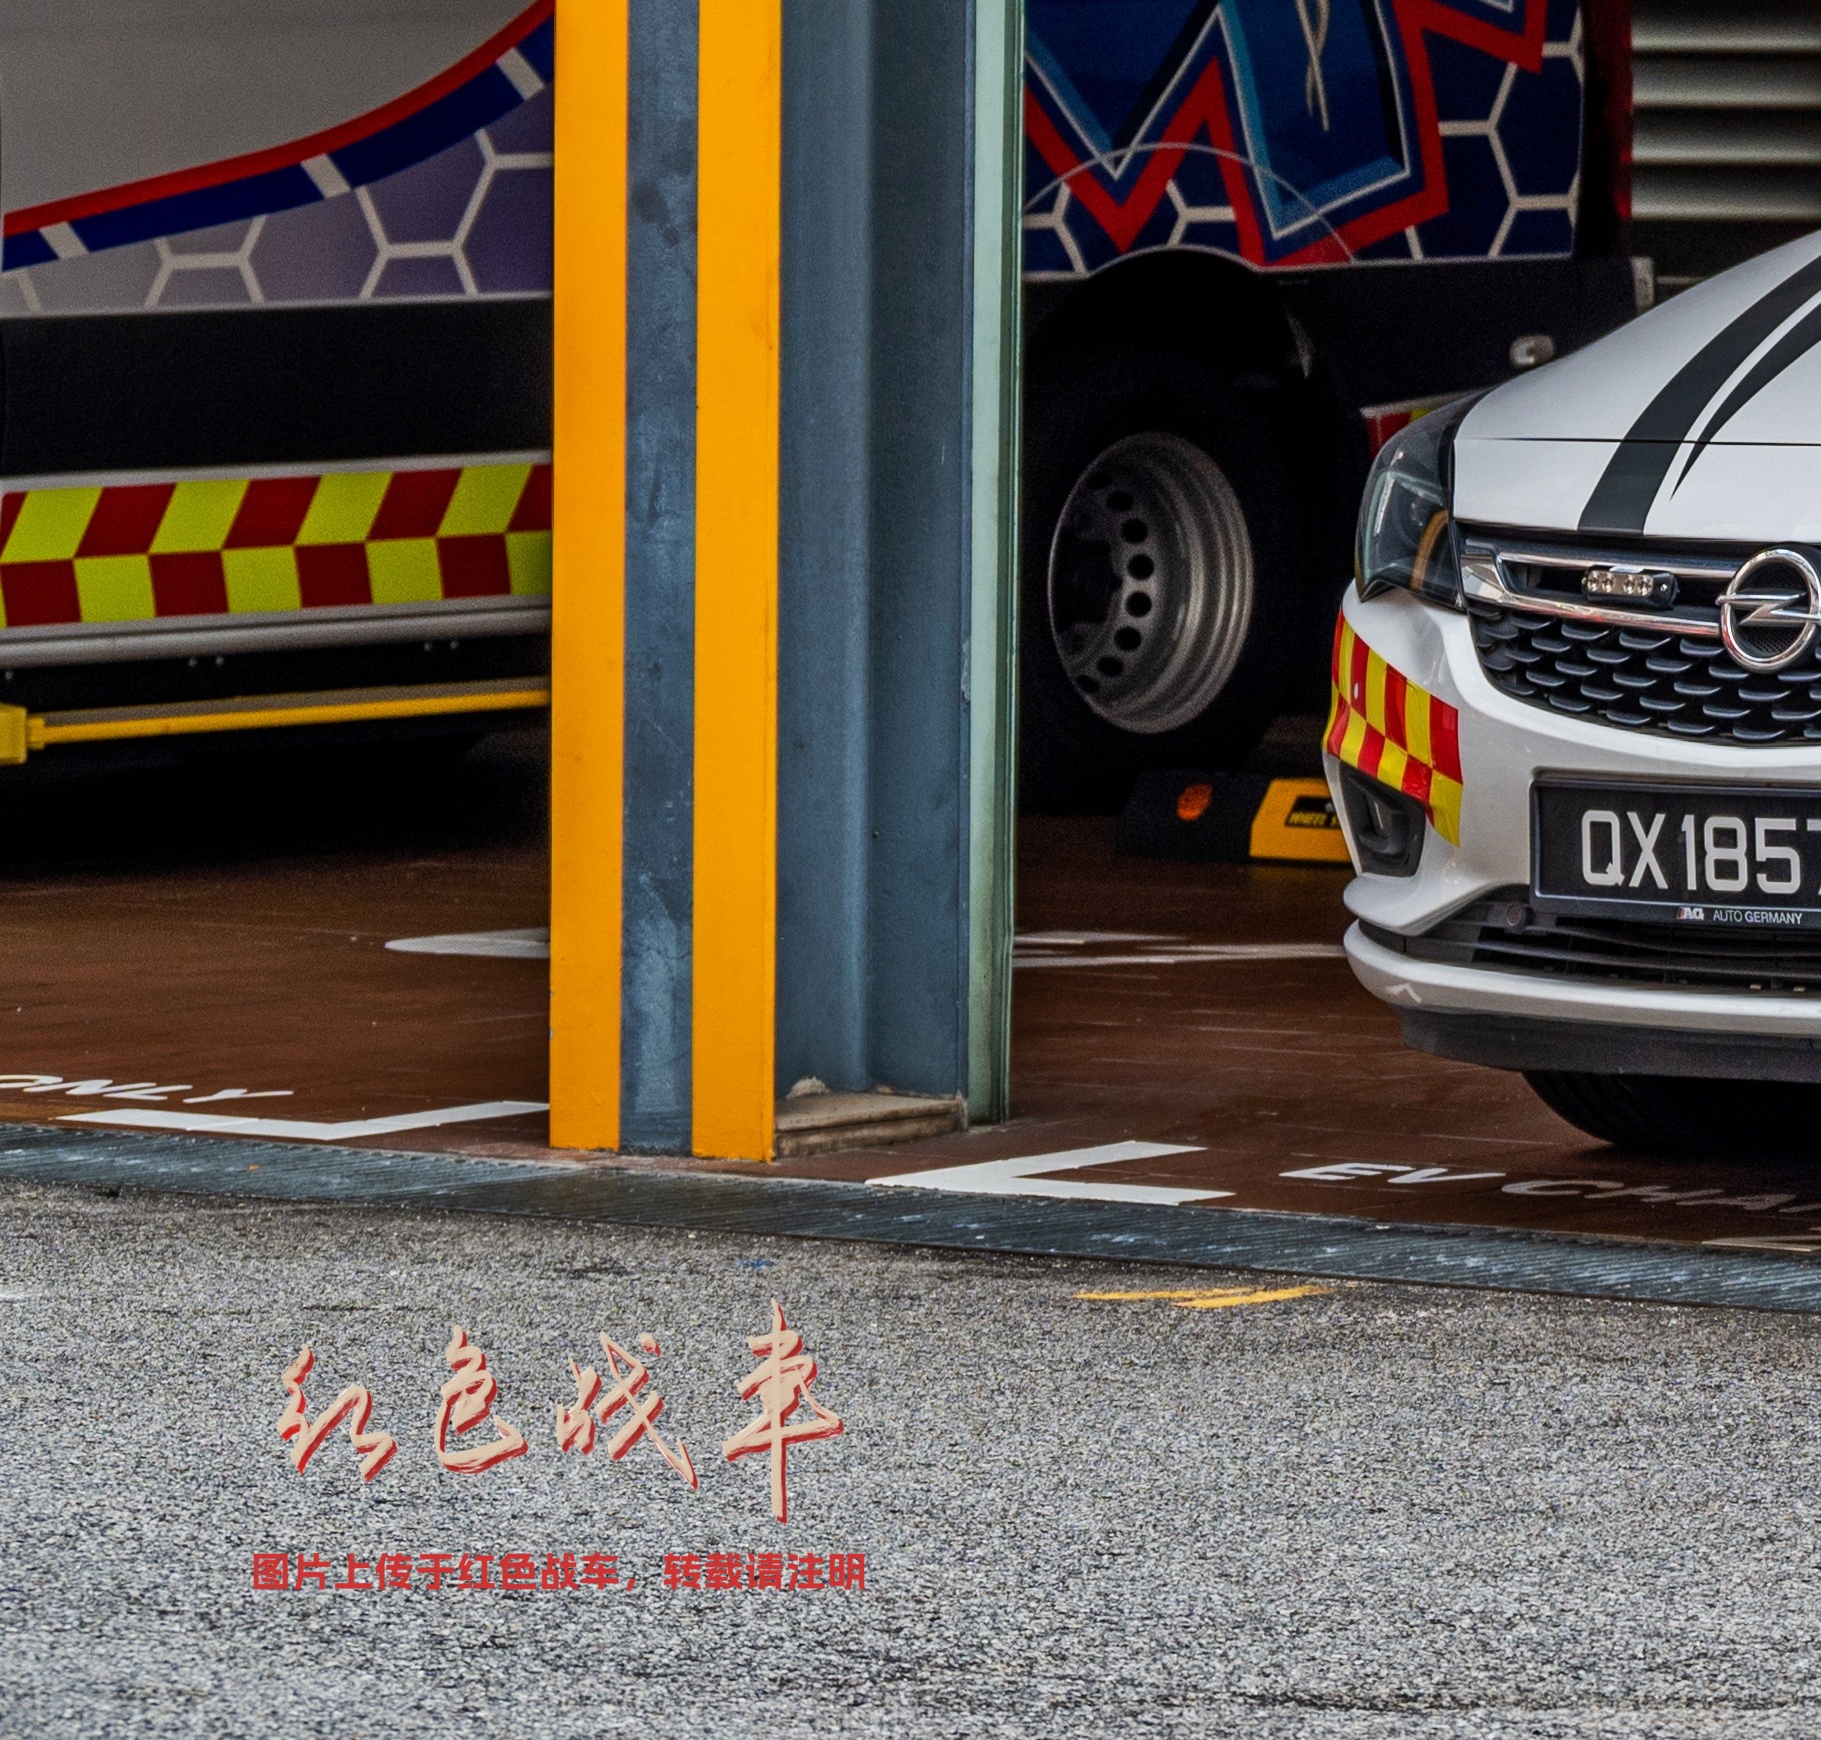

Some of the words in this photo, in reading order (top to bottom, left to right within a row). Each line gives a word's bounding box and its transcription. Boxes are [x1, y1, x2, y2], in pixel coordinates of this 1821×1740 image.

[1713, 910, 1743, 922] AUTO
[1744, 911, 1802, 924] GERMANY
[1279, 1163, 1506, 1185] EV
